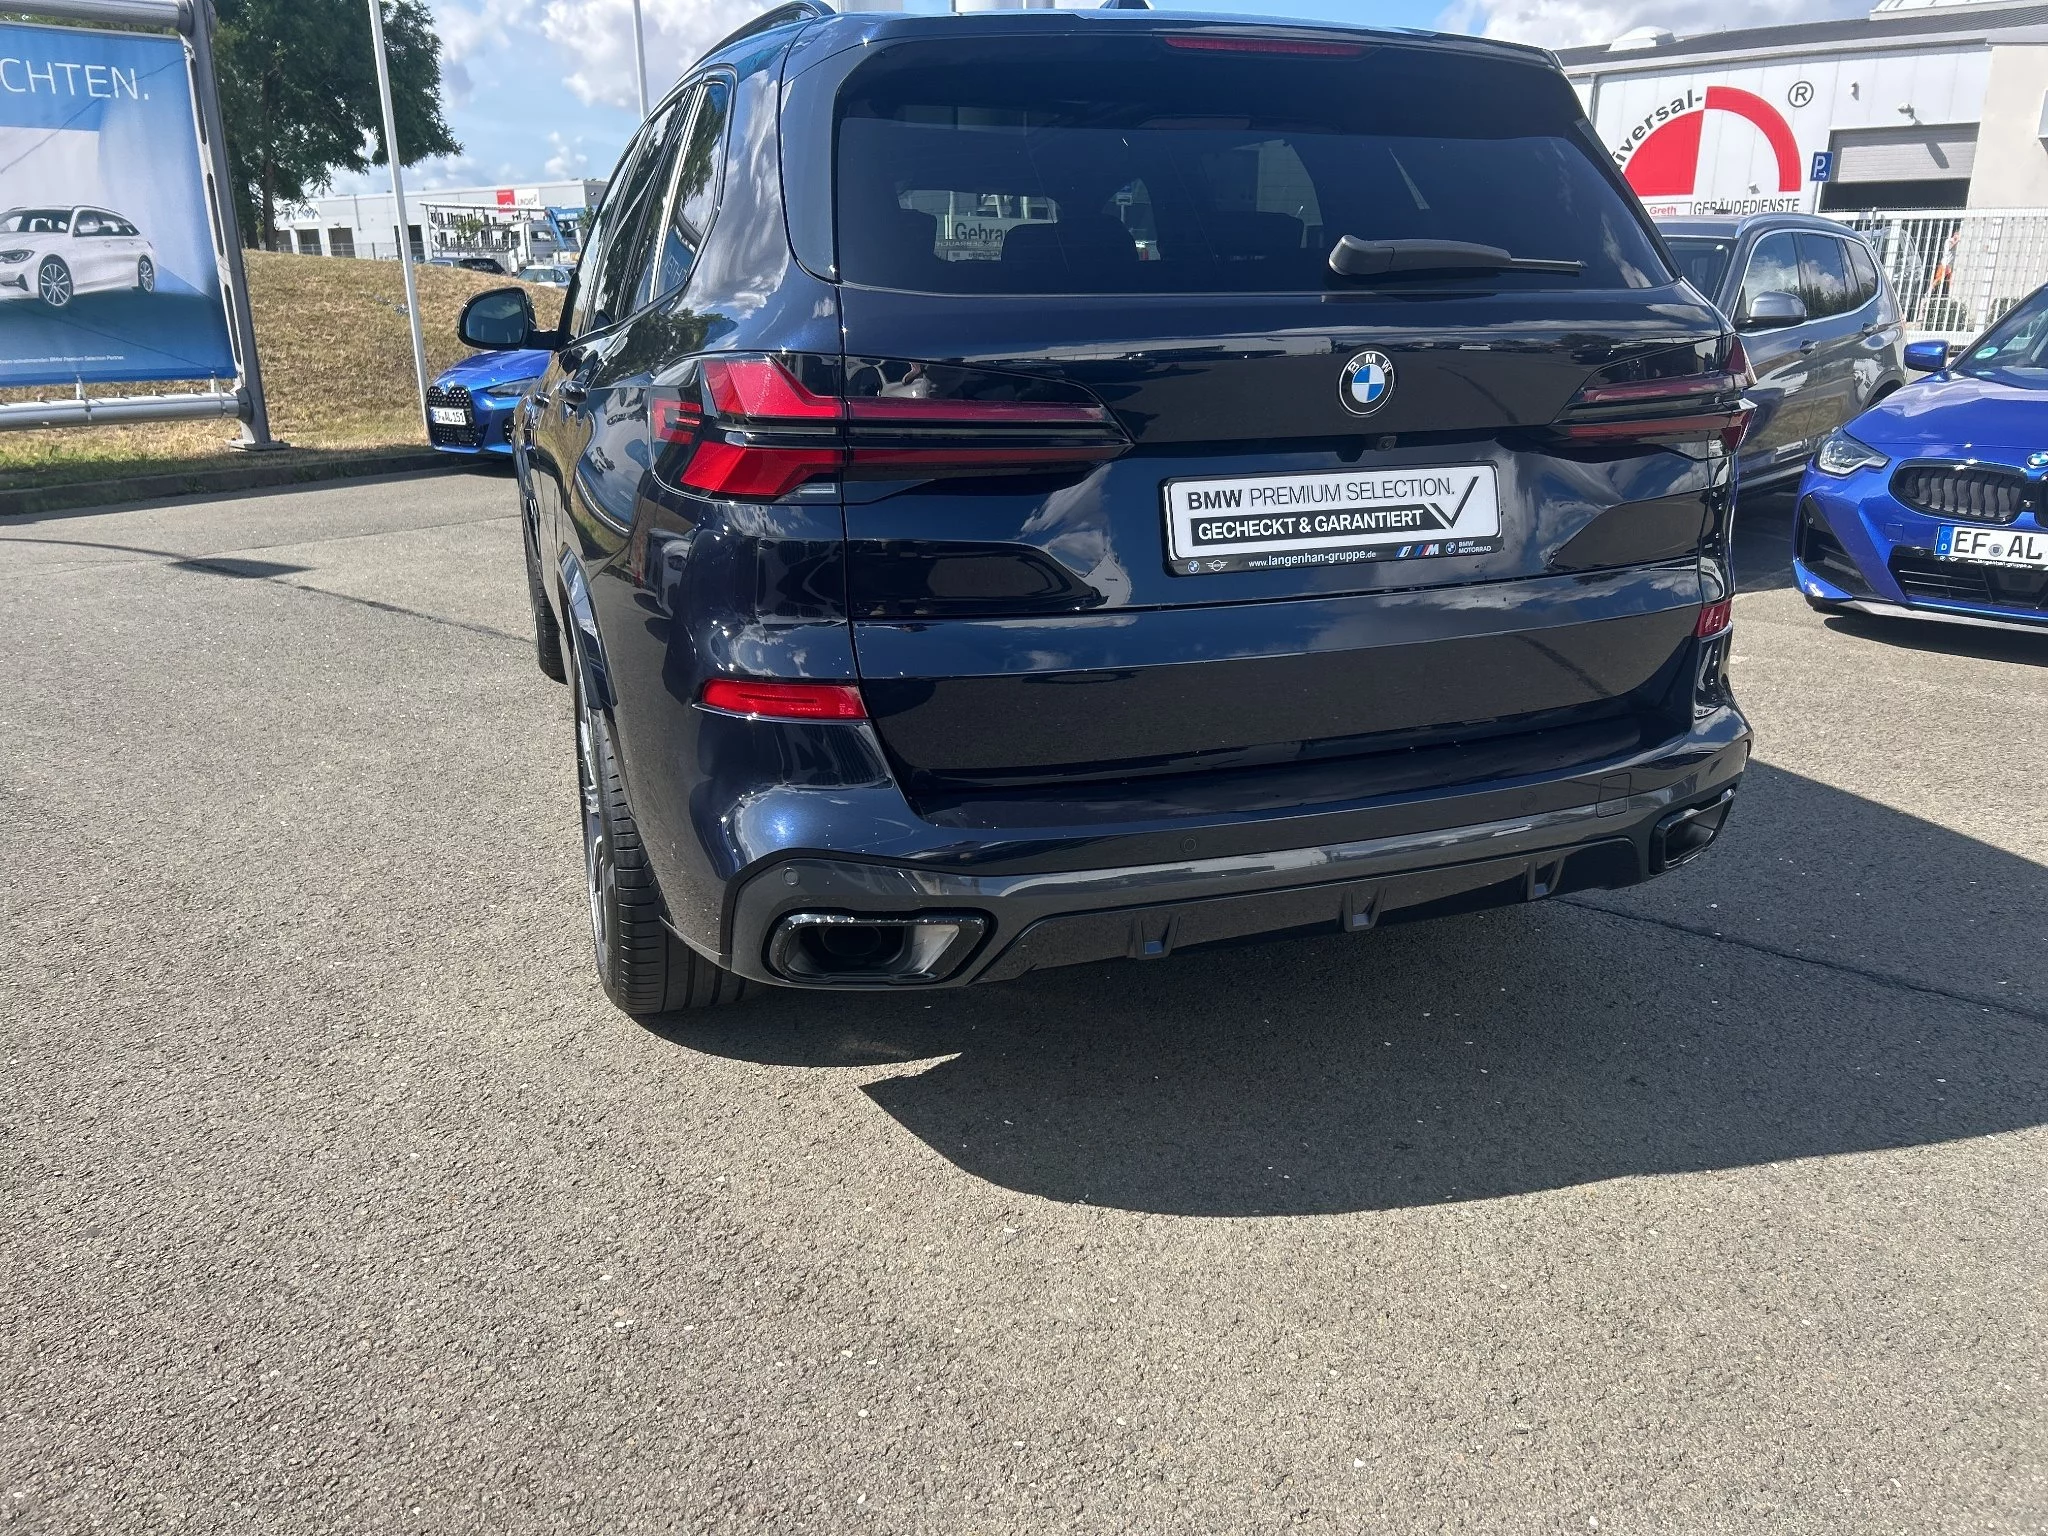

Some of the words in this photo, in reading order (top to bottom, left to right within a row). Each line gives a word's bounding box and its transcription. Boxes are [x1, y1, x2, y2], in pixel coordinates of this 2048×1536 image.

[0, 57, 149, 100] CHTEN.
[1813, 155, 1826, 178] P
[1348, 354, 1393, 374] BMW
[1187, 489, 1242, 510] BMW
[1250, 484, 1341, 506] PREMIUM
[1347, 477, 1455, 501] SELECTION.
[1198, 518, 1296, 540] GECHECKT
[1299, 516, 1312, 534] &
[1314, 509, 1424, 532] GARANTIERT
[1458, 540, 1474, 548] BMW
[1458, 545, 1492, 554] MOTORRAD
[1954, 531, 1991, 554] EF
[2007, 536, 2043, 559] AL
[1248, 550, 1377, 567] www.langenhan-gruppe.de
